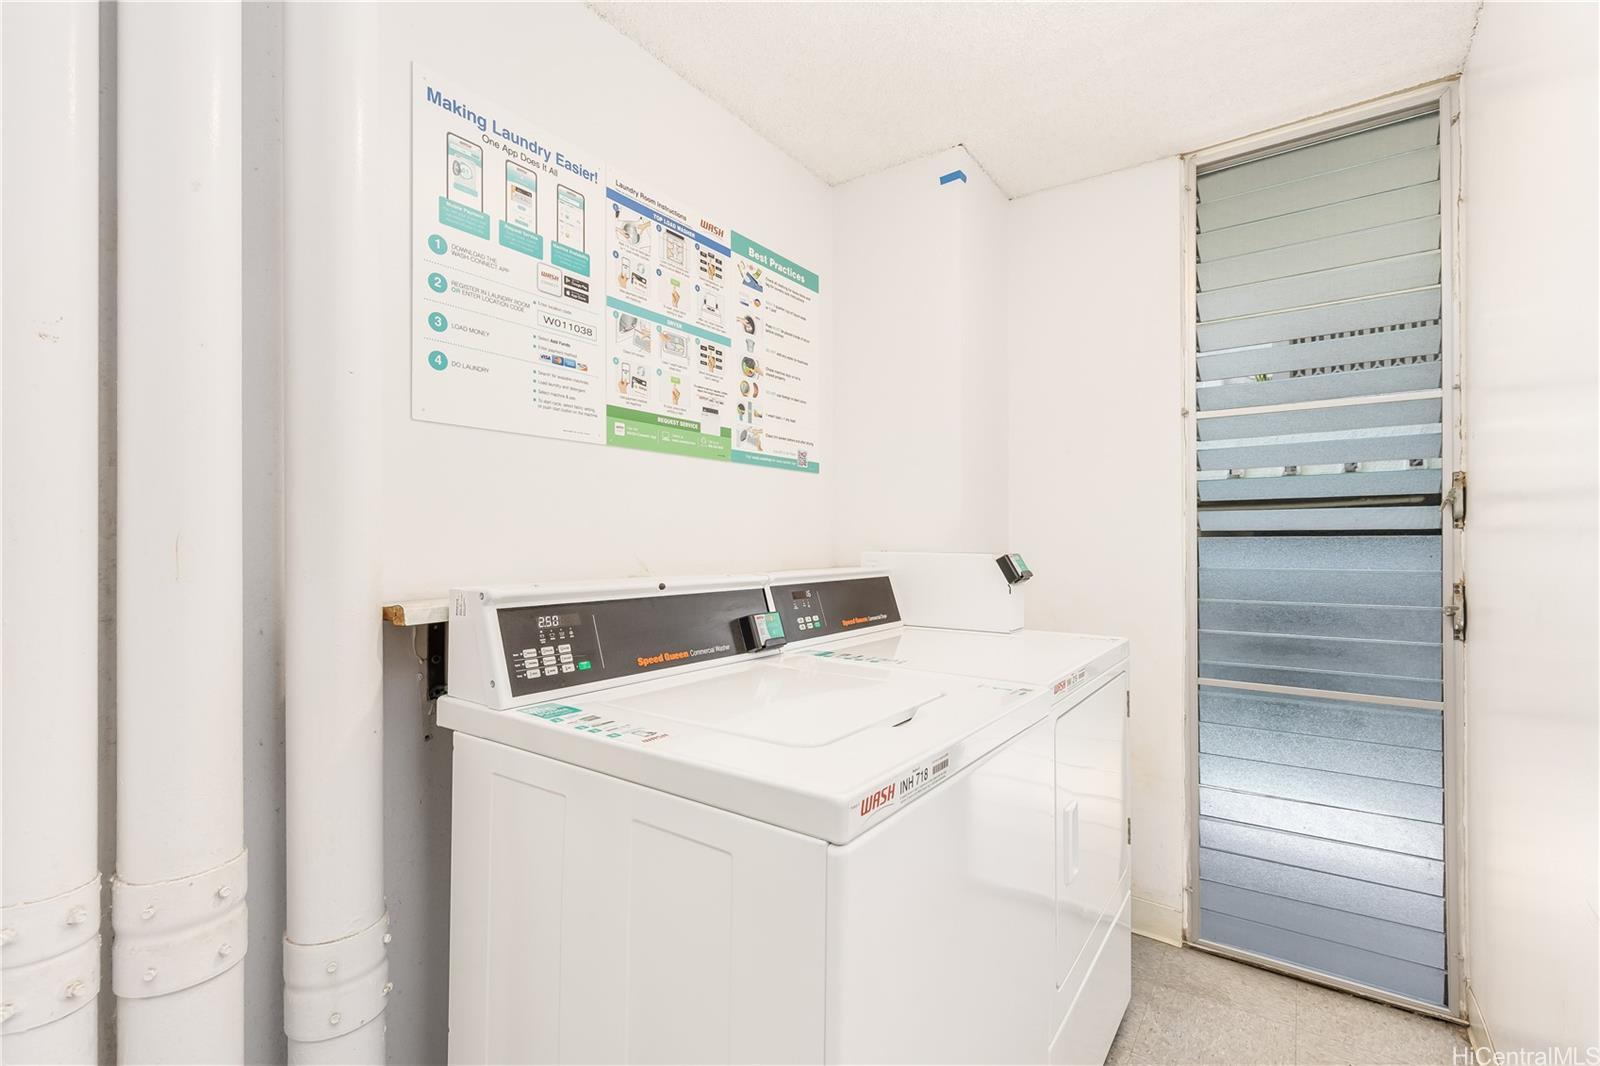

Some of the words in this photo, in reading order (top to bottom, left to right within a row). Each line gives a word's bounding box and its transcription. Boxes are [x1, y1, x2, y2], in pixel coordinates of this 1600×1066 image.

[427, 86, 487, 132] Making
[493, 119, 552, 162] Laundry
[556, 152, 598, 184] Easier!
[482, 134, 500, 149] One
[502, 145, 519, 158] App
[521, 152, 540, 168] Does
[542, 163, 548, 172] It
[549, 167, 558, 177] All
[615, 179, 639, 198] Laundry
[640, 192, 657, 206] Room
[657, 200, 687, 221] Instructions
[652, 213, 663, 222] TOP
[700, 219, 724, 238] WASH
[434, 239, 441, 250] 1
[451, 244, 486, 260] DOWNLOAD
[487, 255, 497, 263] THE
[748, 247, 768, 264] Best
[769, 258, 805, 283] Practices
[434, 277, 441, 288] 2
[451, 280, 480, 294] REGISTER
[481, 288, 487, 296] IN
[488, 290, 513, 304] LAUNDRY
[514, 299, 531, 309] ROOM
[451, 286, 461, 294] OR
[462, 290, 481, 300] ENTER
[482, 295, 509, 309] LOCATION
[510, 304, 525, 313] CODE
[434, 316, 442, 327] 3
[451, 323, 468, 332] LOAD
[469, 327, 490, 337] MONEY
[543, 315, 594, 337] W011038
[434, 355, 442, 365] 4
[451, 360, 461, 368] DO
[462, 363, 489, 373] LAUNDRY
[657, 417, 679, 427] REQUEST
[680, 419, 699, 430] SERVICE
[538, 615, 559, 628] 2.50
[637, 653, 663, 667] Speed
[664, 651, 689, 662] Queen
[689, 647, 714, 657] Commercial
[715, 645, 730, 653] Washer
[860, 783, 896, 816] WASH
[900, 775, 914, 795] INH
[916, 767, 929, 785] 718
